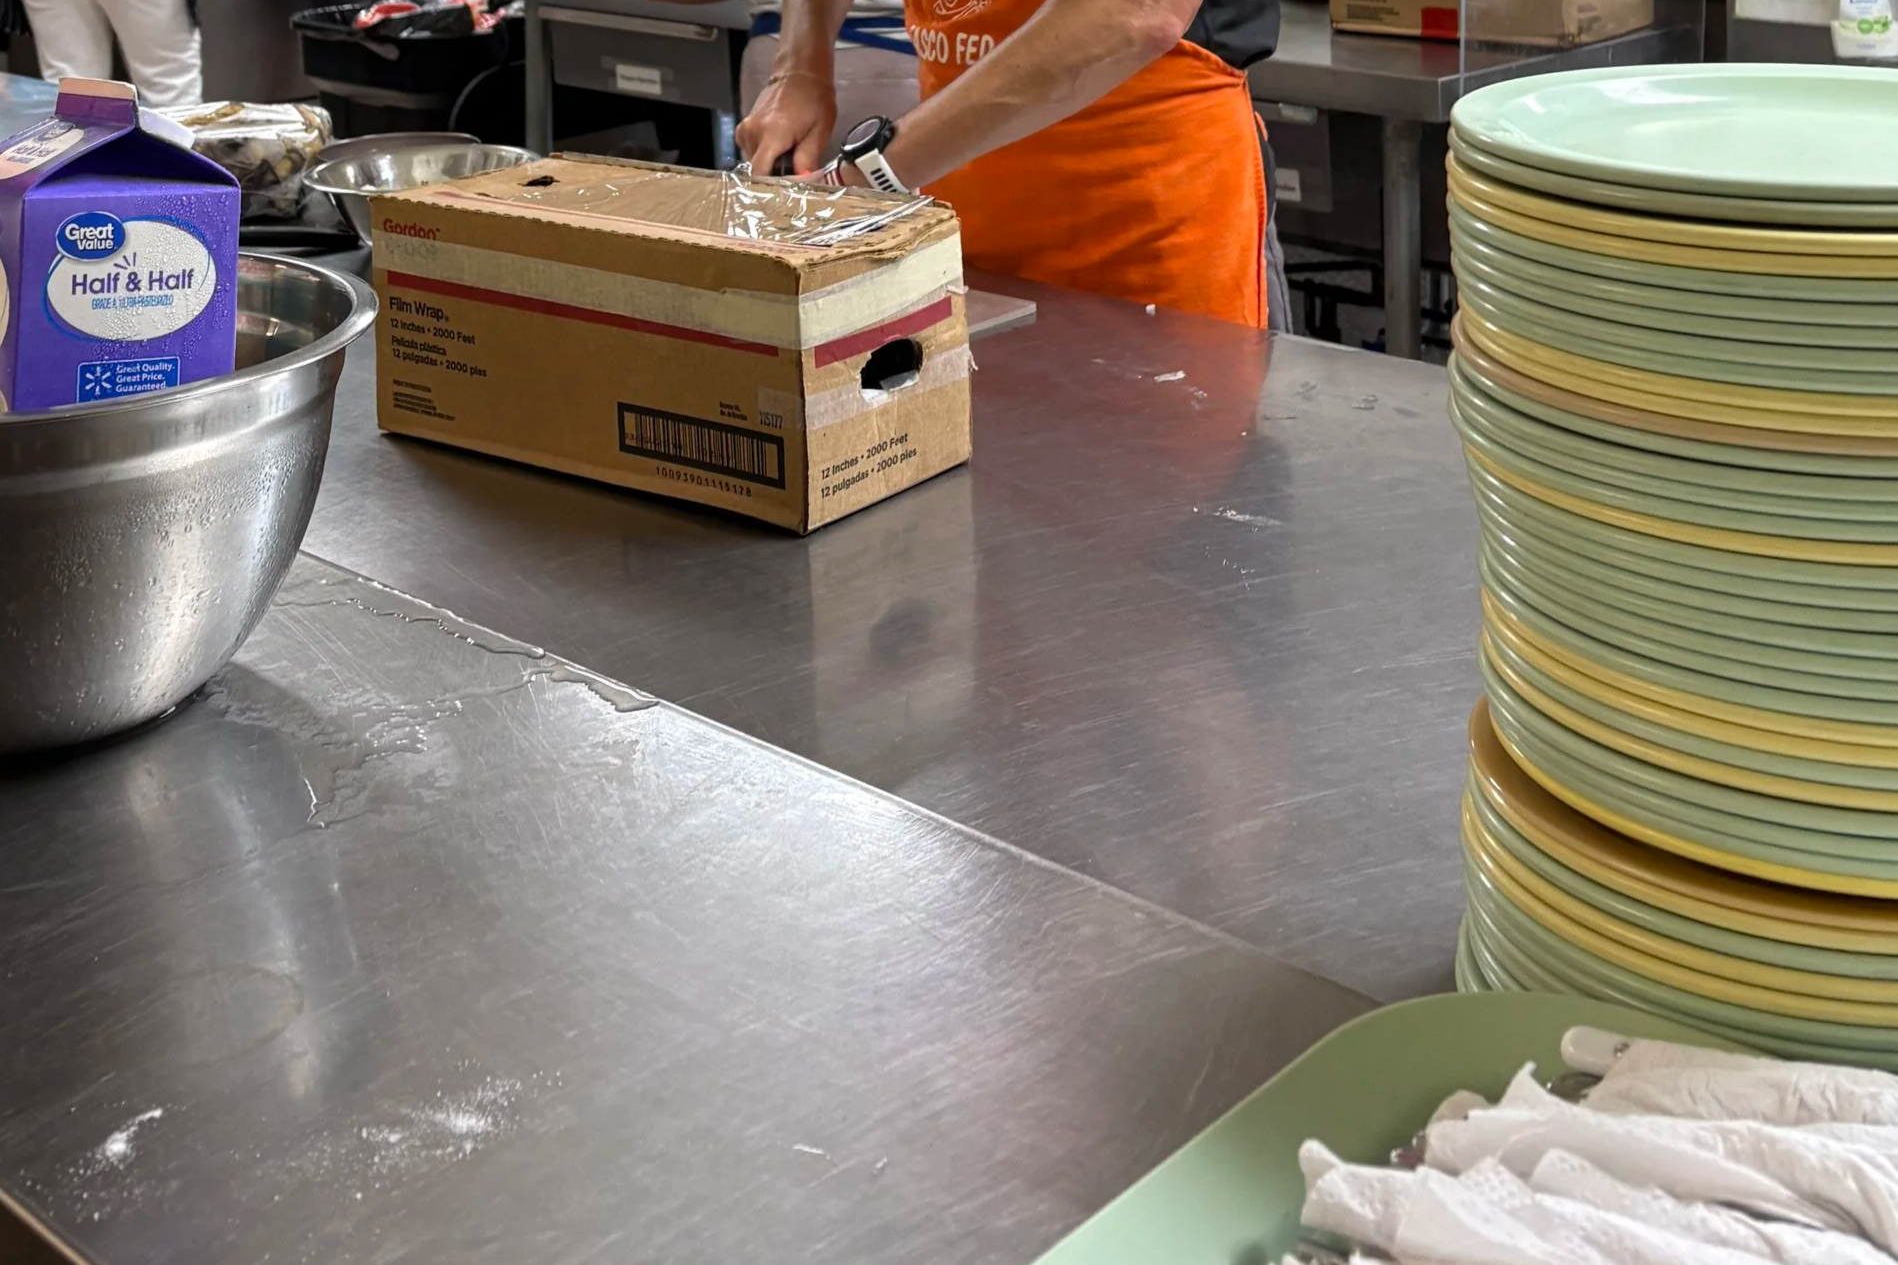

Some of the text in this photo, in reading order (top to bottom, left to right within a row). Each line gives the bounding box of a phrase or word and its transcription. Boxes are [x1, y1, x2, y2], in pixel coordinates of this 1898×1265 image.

[65, 223, 114, 240] Great
[383, 217, 437, 241] Gordon
[76, 238, 115, 250] Value
[71, 268, 195, 295] Half & Half
[389, 296, 444, 322] Film Wrap
[390, 318, 399, 329] 12
[432, 326, 456, 341] 2000
[456, 331, 476, 345] Feet
[141, 362, 175, 372] Quality.
[392, 348, 488, 378] 12 pulgadas 2000 pies
[116, 372, 165, 383] Great Price.
[821, 467, 830, 481] 12
[866, 440, 889, 460] 2000
[889, 432, 909, 449] Feet
[820, 447, 918, 499] 12 pulgadas 2000 pies
